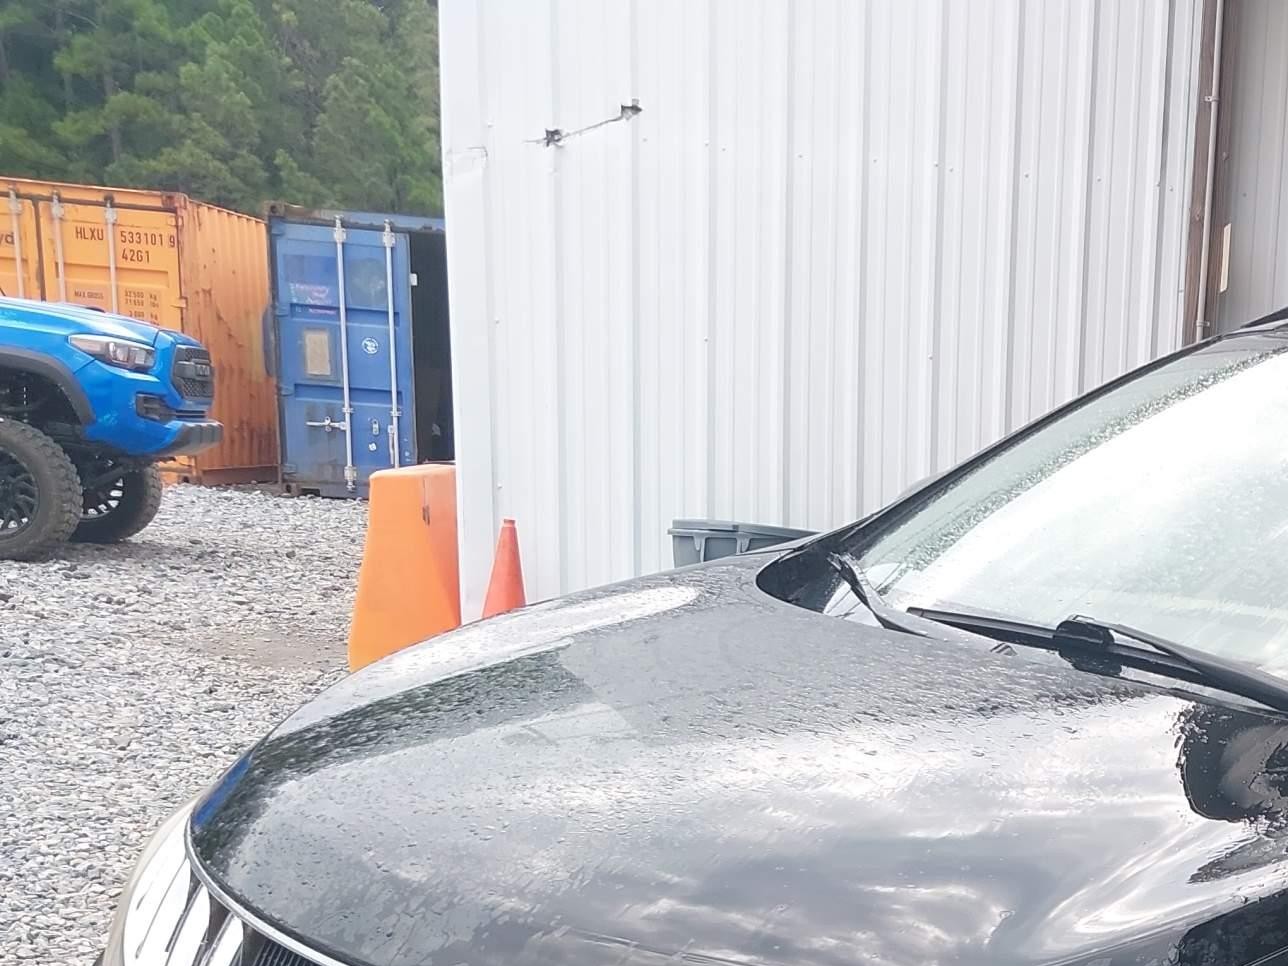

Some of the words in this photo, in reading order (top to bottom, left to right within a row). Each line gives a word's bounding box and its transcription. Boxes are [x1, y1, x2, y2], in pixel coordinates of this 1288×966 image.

[75, 226, 104, 241] HLXU
[120, 230, 164, 247] 533101
[168, 234, 176, 248] 9
[121, 249, 150, 264] 42G1
